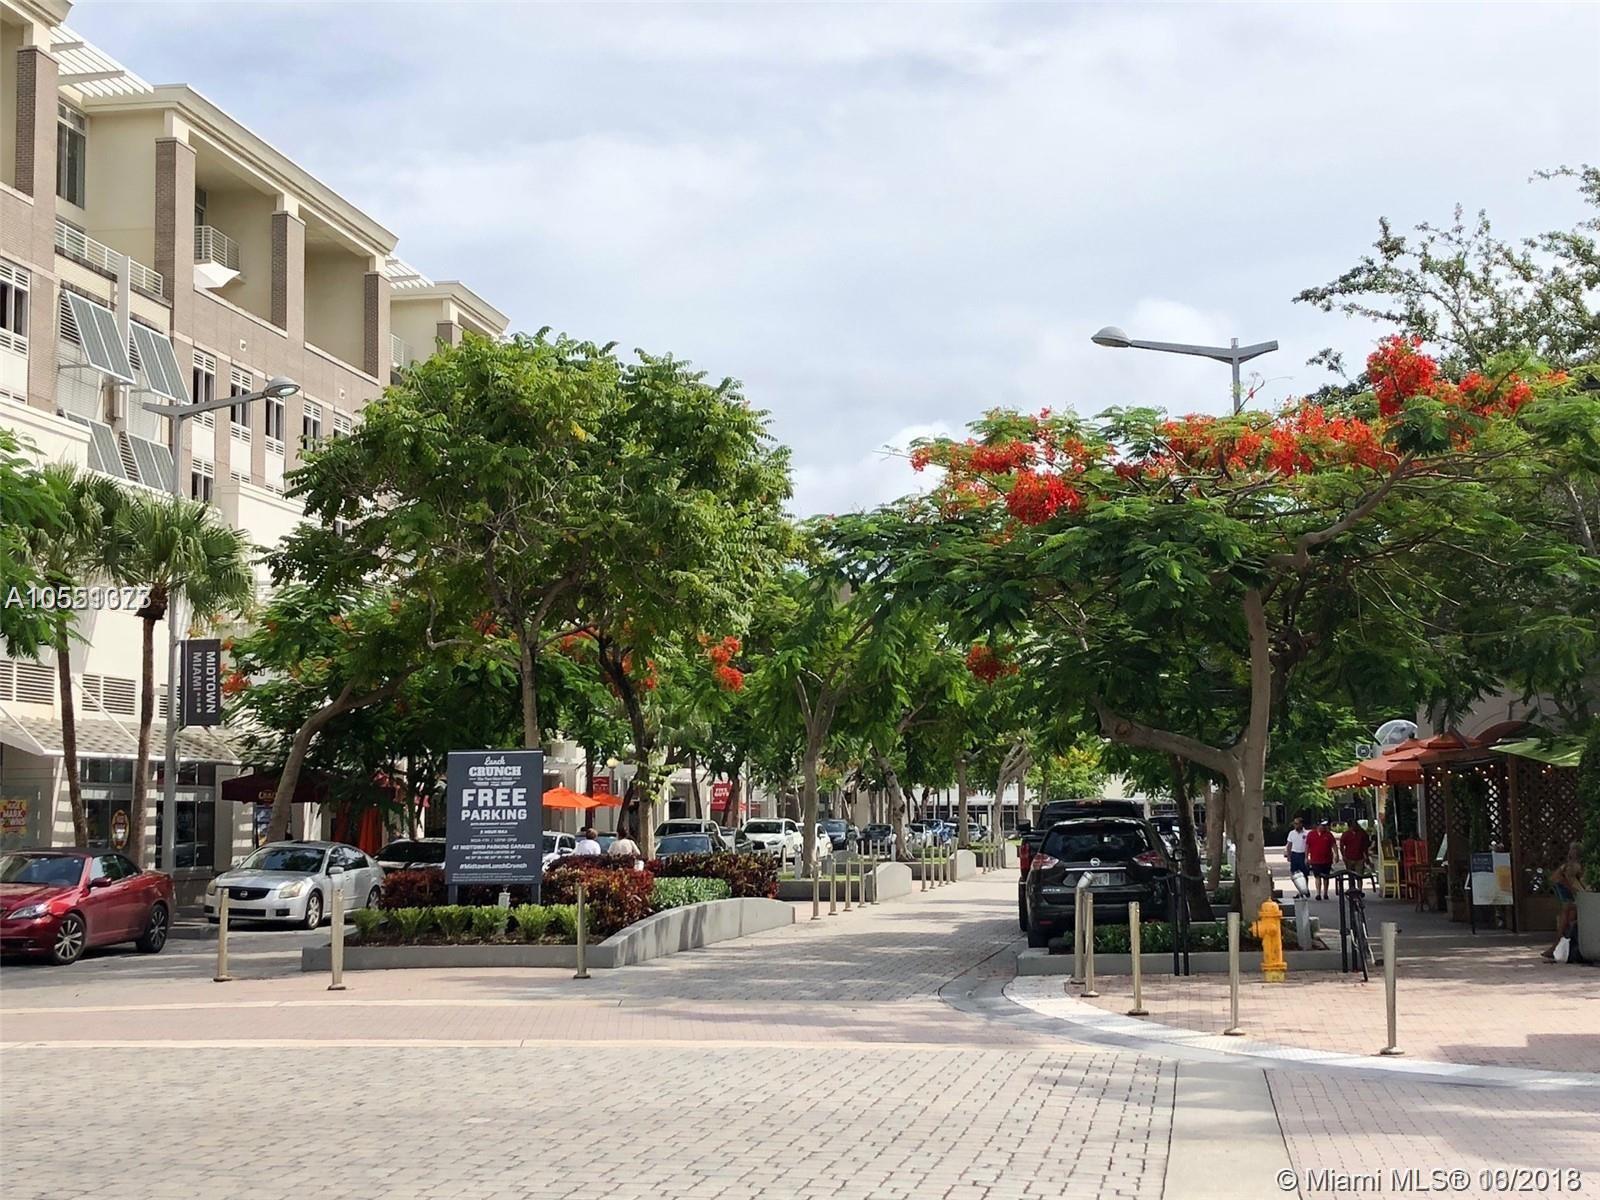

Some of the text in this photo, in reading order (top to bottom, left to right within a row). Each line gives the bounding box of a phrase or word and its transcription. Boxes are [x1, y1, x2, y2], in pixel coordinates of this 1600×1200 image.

[192, 652, 202, 691] MIAMI
[205, 651, 216, 713] MIDTOWN
[468, 766, 522, 777] CRUNCH
[462, 788, 527, 807] FREE
[461, 809, 528, 821] PARKING
